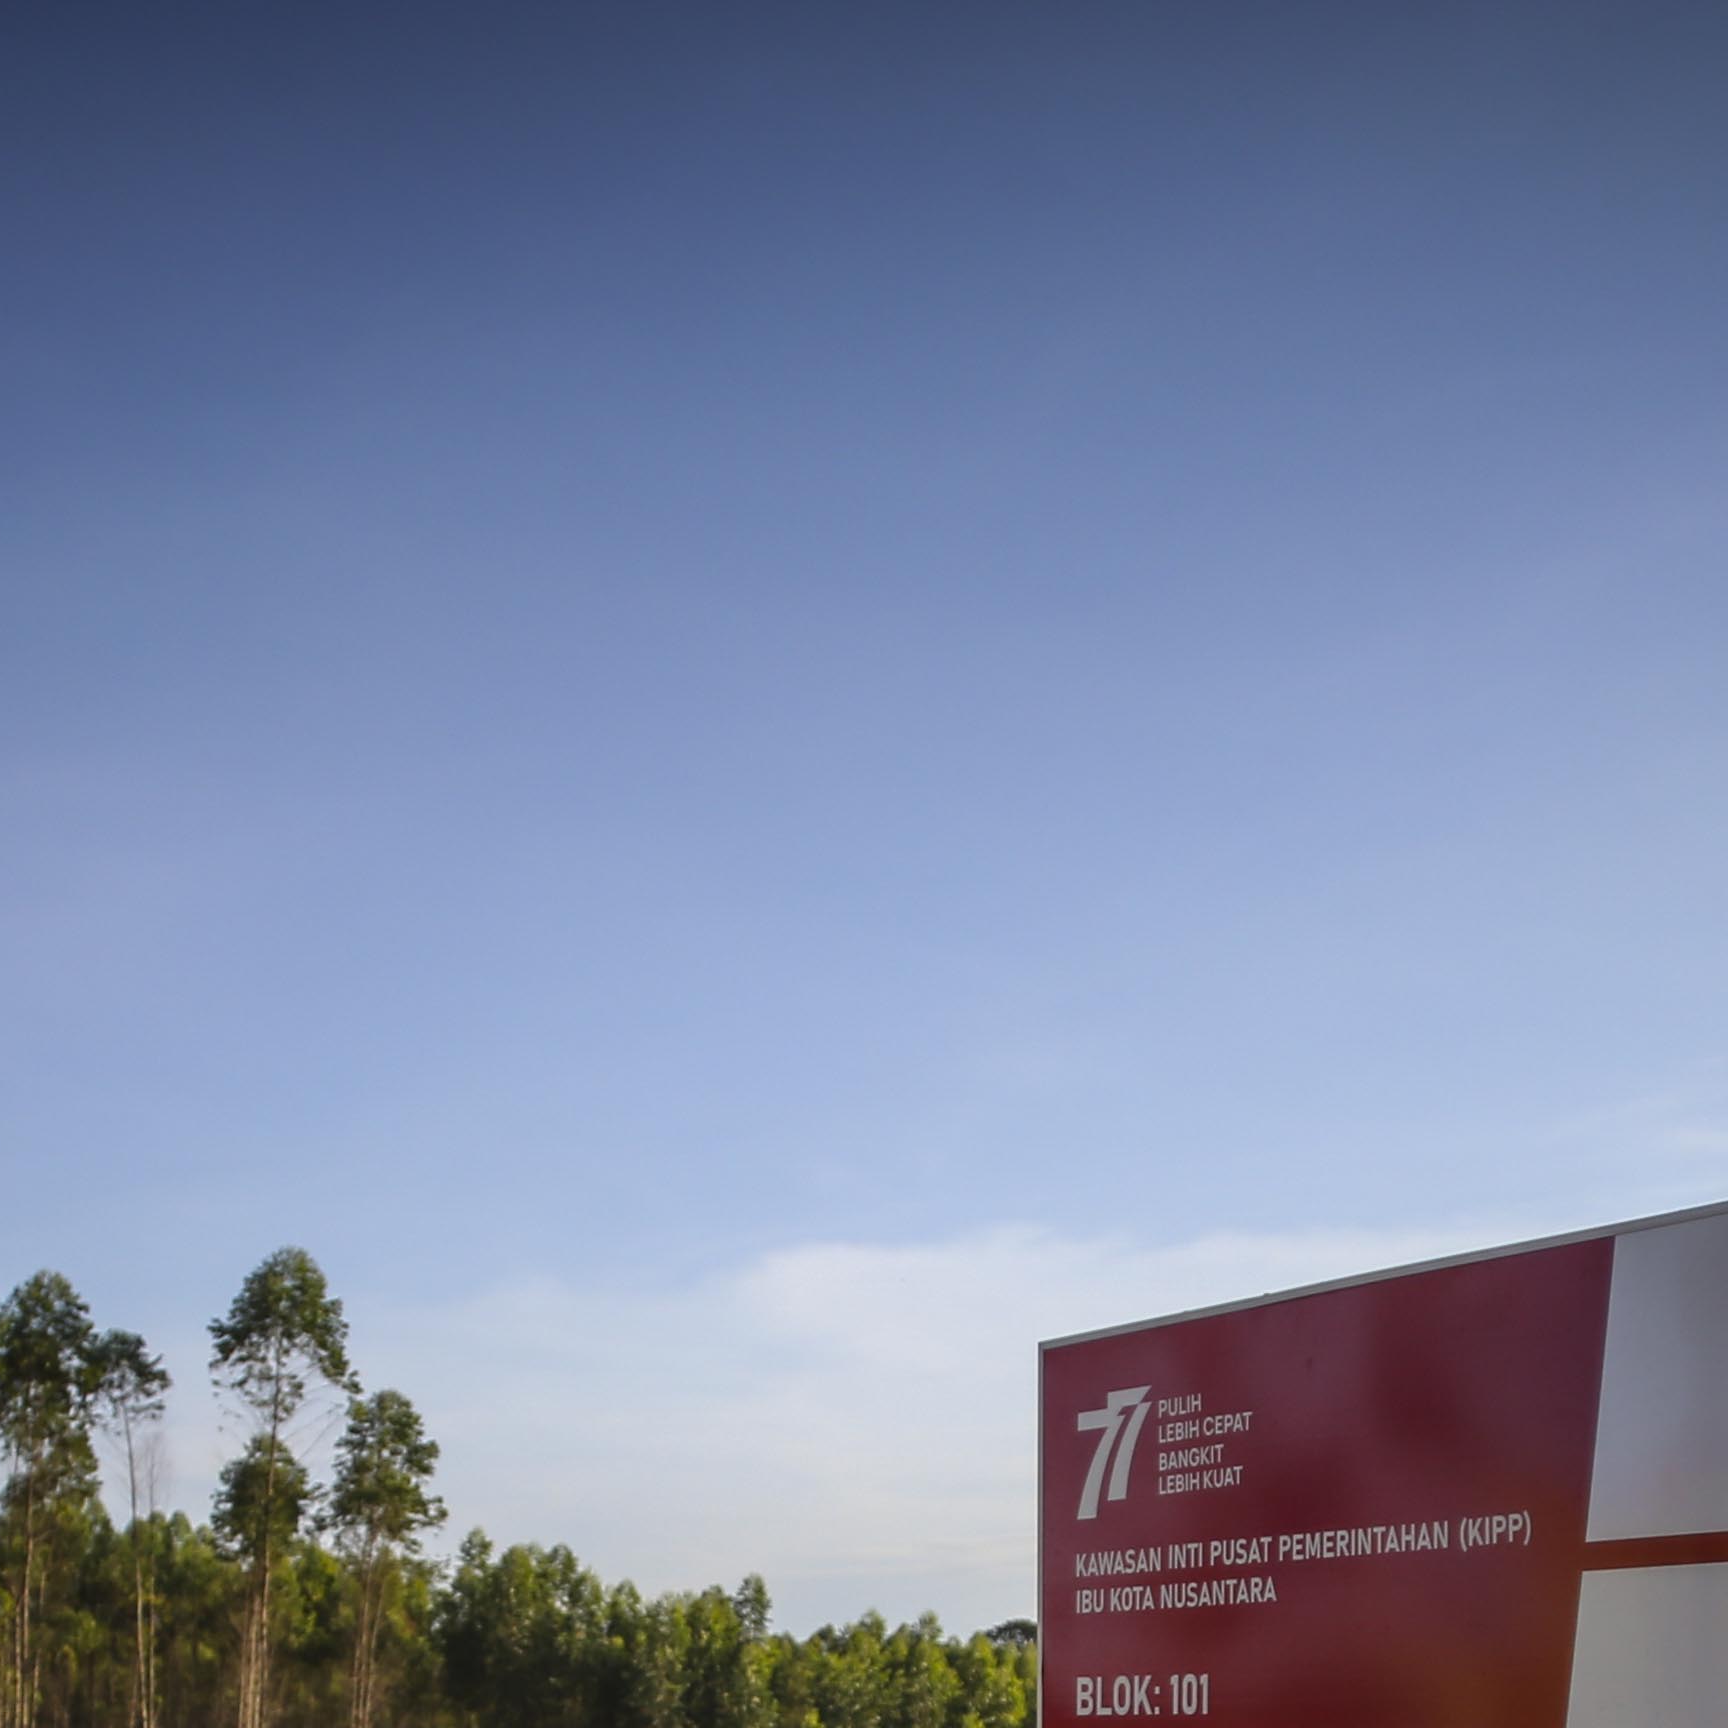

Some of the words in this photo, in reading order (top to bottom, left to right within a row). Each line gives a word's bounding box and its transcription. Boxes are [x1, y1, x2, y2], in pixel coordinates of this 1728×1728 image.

[1158, 1393, 1202, 1419] PULIH
[1158, 1419, 1200, 1443] LEBIH
[1203, 1411, 1253, 1436] CEPAT
[1077, 1385, 1152, 1520] 77
[1158, 1444, 1224, 1471] BANGKIT
[1158, 1471, 1200, 1495] LEBIH
[1203, 1466, 1243, 1489] KUAT
[1076, 1547, 1161, 1577] KAWASAN
[1168, 1543, 1203, 1569] INTI
[1210, 1536, 1272, 1566] PUSAT
[1279, 1520, 1448, 1562] PEMERINTAHAN
[1459, 1510, 1532, 1553] (KIPP)
[1076, 1589, 1104, 1614] IBU
[1110, 1585, 1155, 1612] KOTA
[1160, 1576, 1277, 1609] NUSANTARA
[1076, 1675, 1160, 1716] BLOK:
[1171, 1673, 1209, 1715] 101
